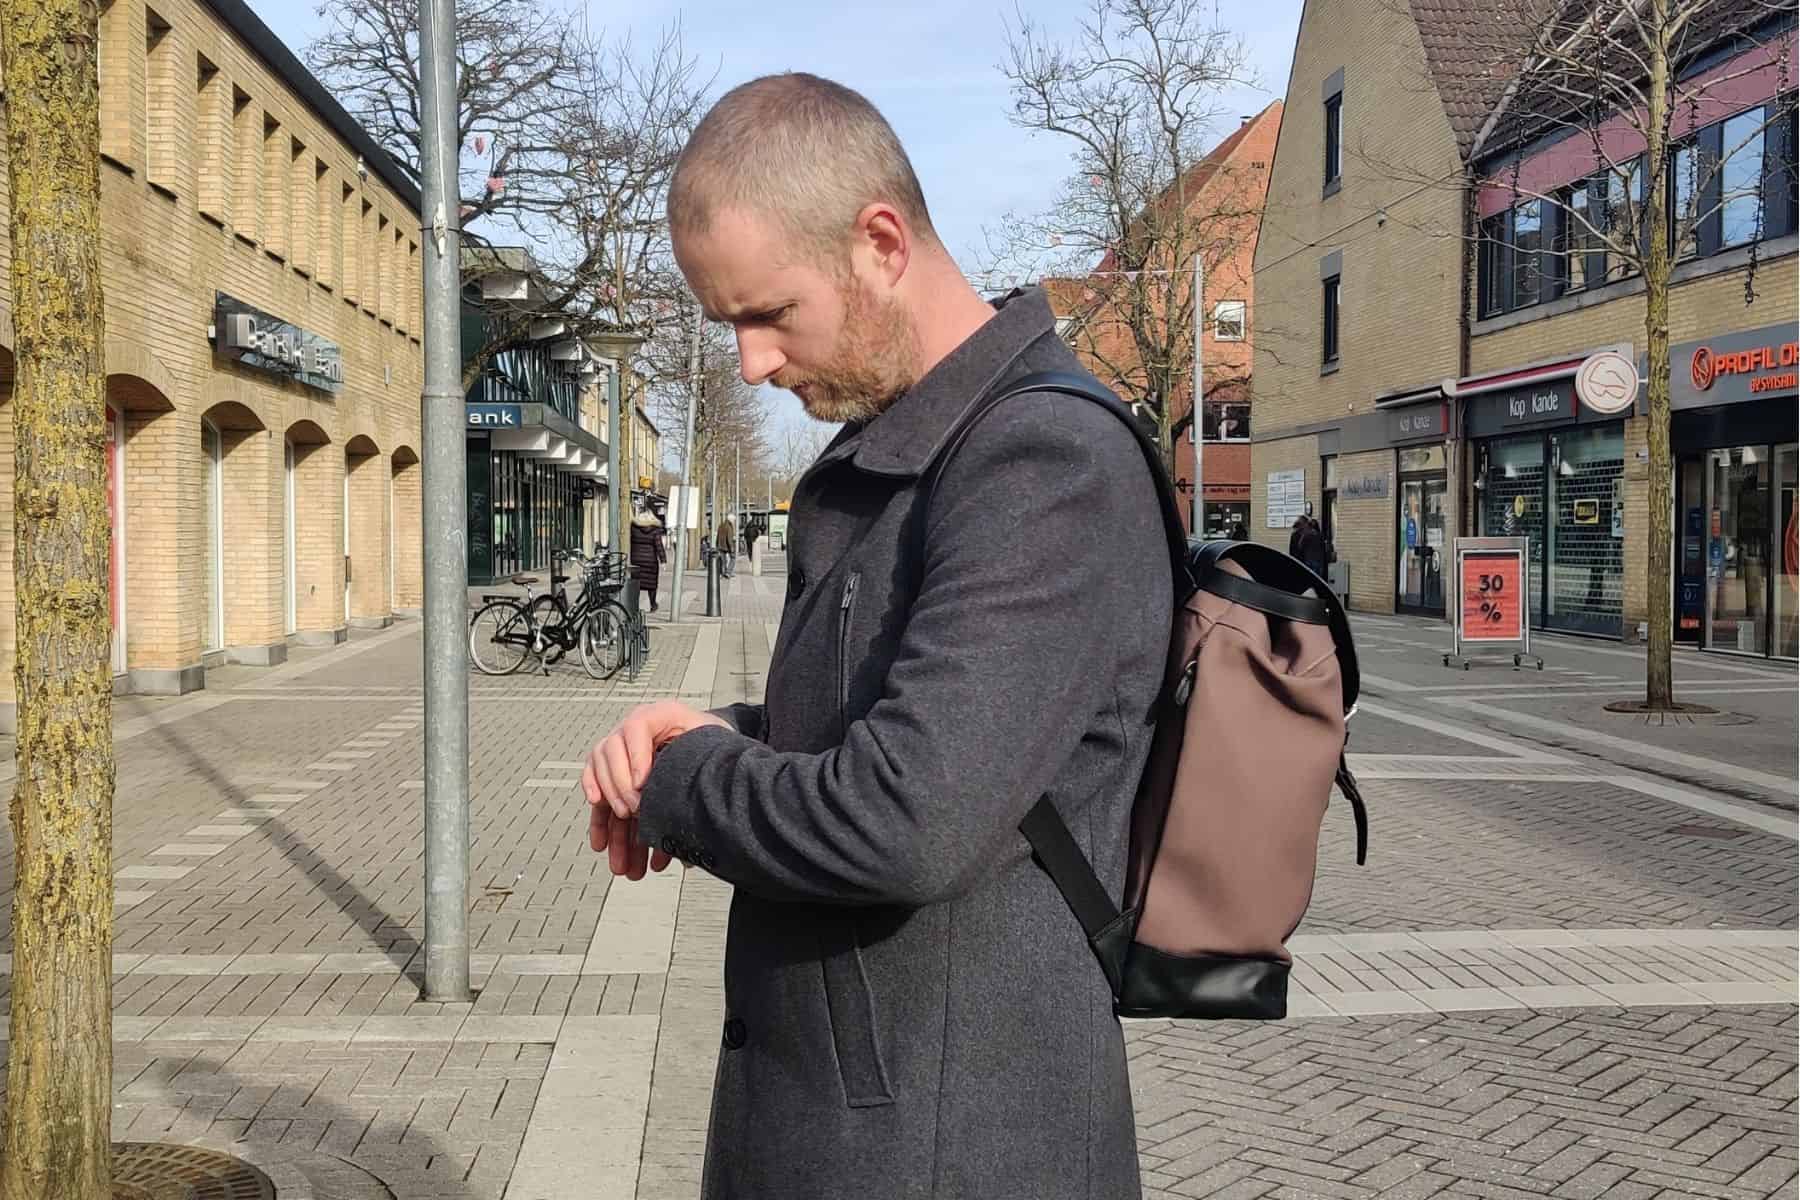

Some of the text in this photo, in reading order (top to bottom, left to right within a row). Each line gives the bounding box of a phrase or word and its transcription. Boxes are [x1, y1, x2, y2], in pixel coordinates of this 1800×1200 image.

[1714, 346, 1777, 377] PROFIL
[1509, 390, 1559, 419] Kop Kande
[469, 409, 513, 425] ank
[1479, 574, 1504, 592] 30
[1481, 602, 1503, 623] %
